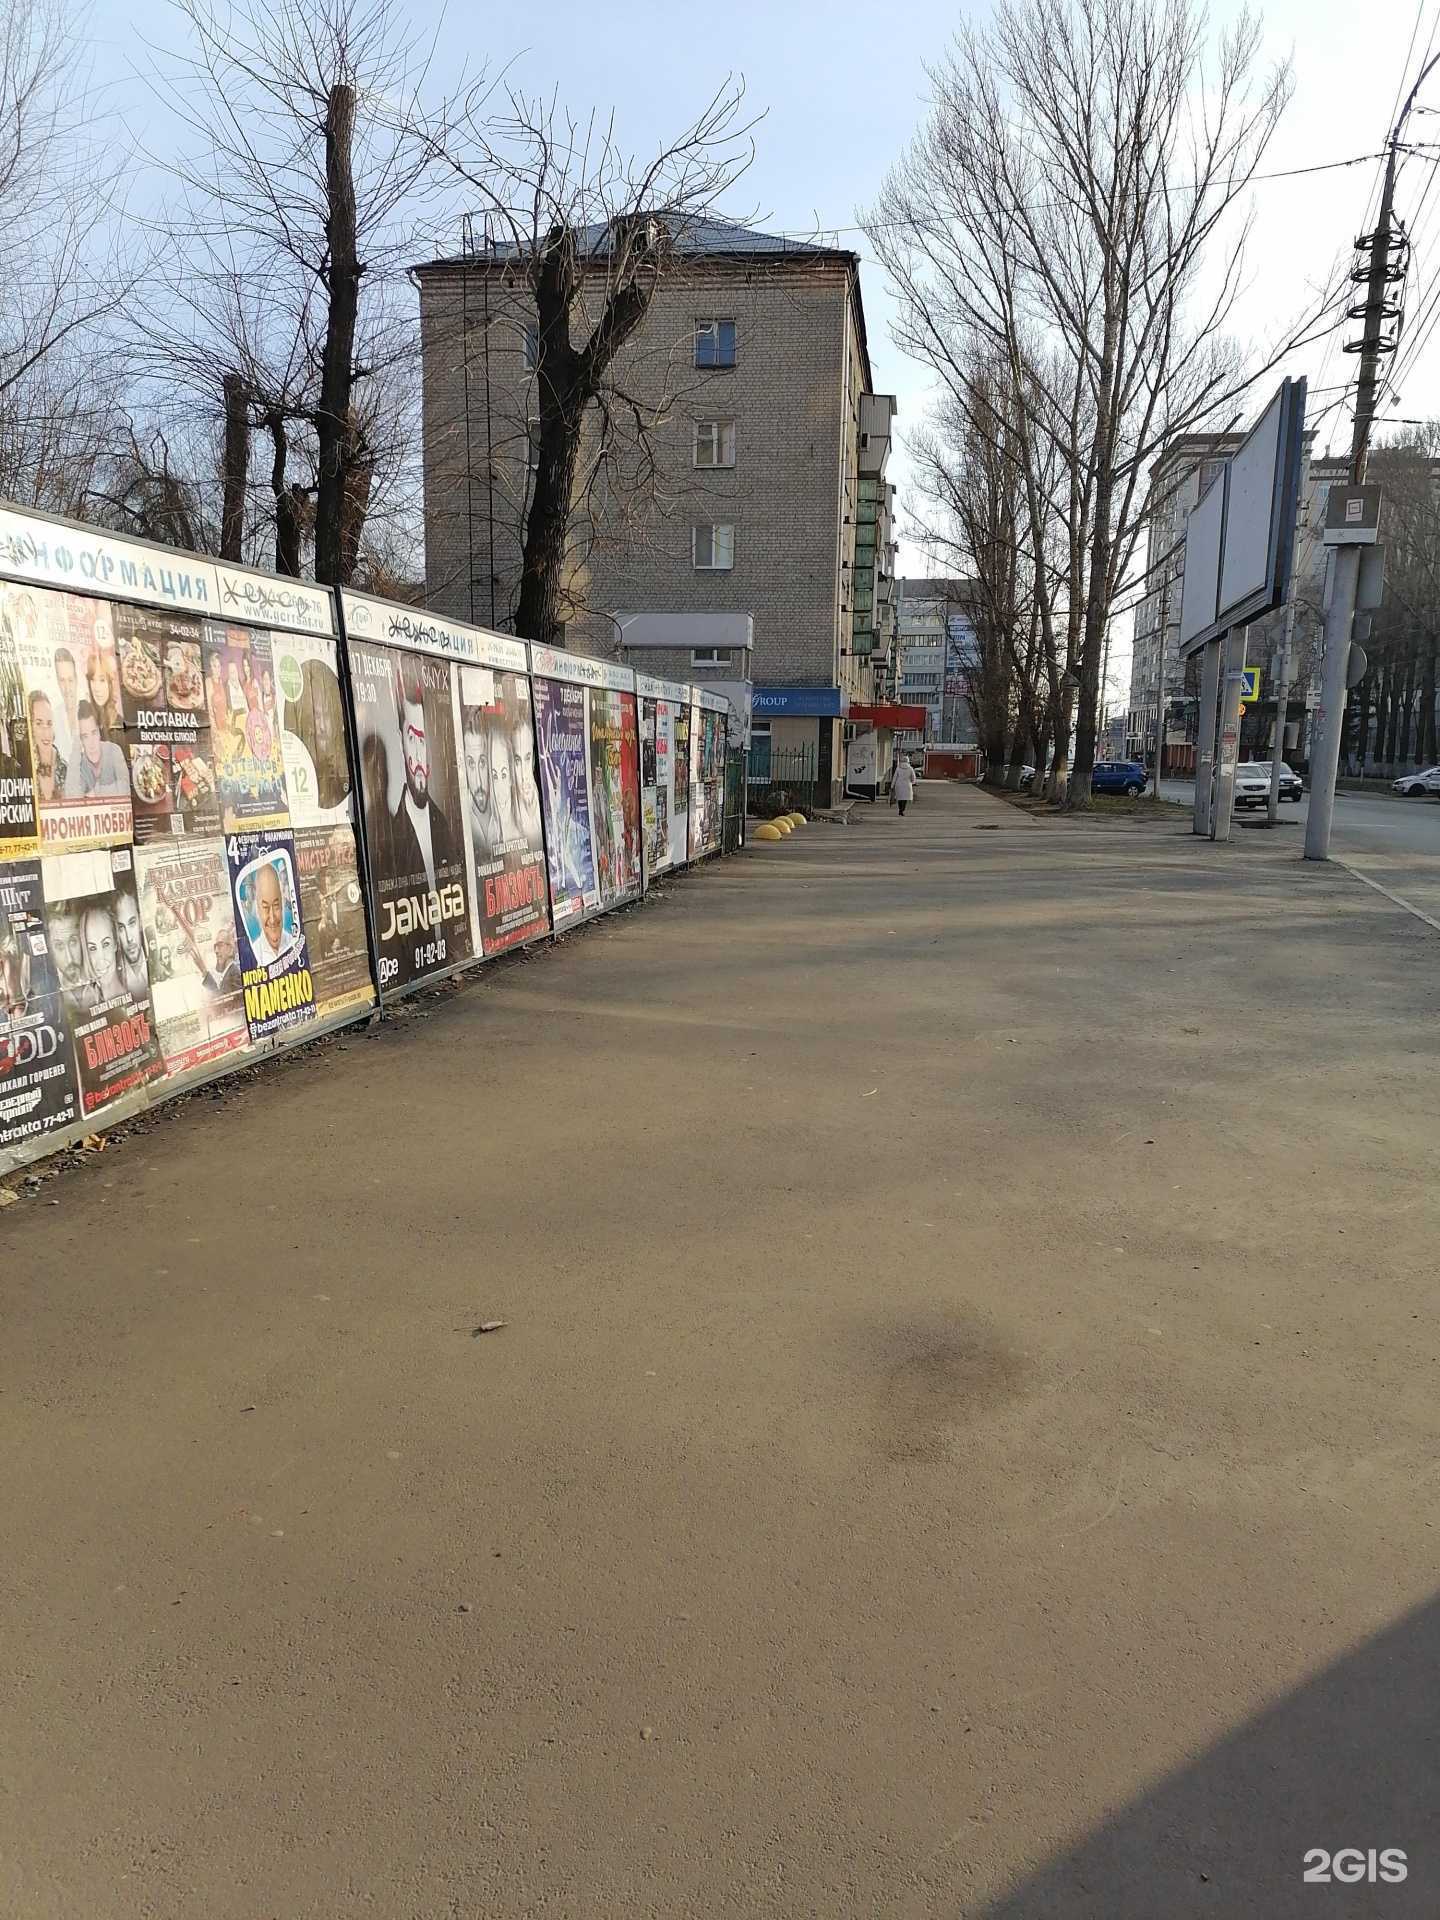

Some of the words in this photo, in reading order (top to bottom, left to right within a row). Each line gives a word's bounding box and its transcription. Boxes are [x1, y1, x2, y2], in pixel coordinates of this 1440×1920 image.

[350, 652, 360, 674] 17
[356, 682, 376, 703] 19:30
[137, 711, 199, 728] ДОСТАВКА
[141, 731, 173, 742] ВКУСНЫХ
[174, 730, 197, 743] БЛЮД!
[292, 767, 309, 792] 12
[0, 797, 34, 824] РСКИЙ
[41, 815, 92, 841] ИРОНИЯ
[93, 811, 132, 836] ЛЮБВИ
[228, 835, 240, 865] 4
[296, 847, 331, 872] МИСТЕР
[485, 865, 544, 918] БЛИЗОСТЬ
[415, 939, 446, 969] 91-92-03
[242, 967, 268, 986] ИГОРЬ
[244, 969, 313, 1022] МАМЕНКО
[83, 1013, 151, 1069] БЛИЗОСТЬ
[0, 1076, 28, 1094] ИХАИЛ
[29, 1063, 66, 1084] ГОРШЕНЕВ
[42, 1108, 75, 1129] 77-42-11
